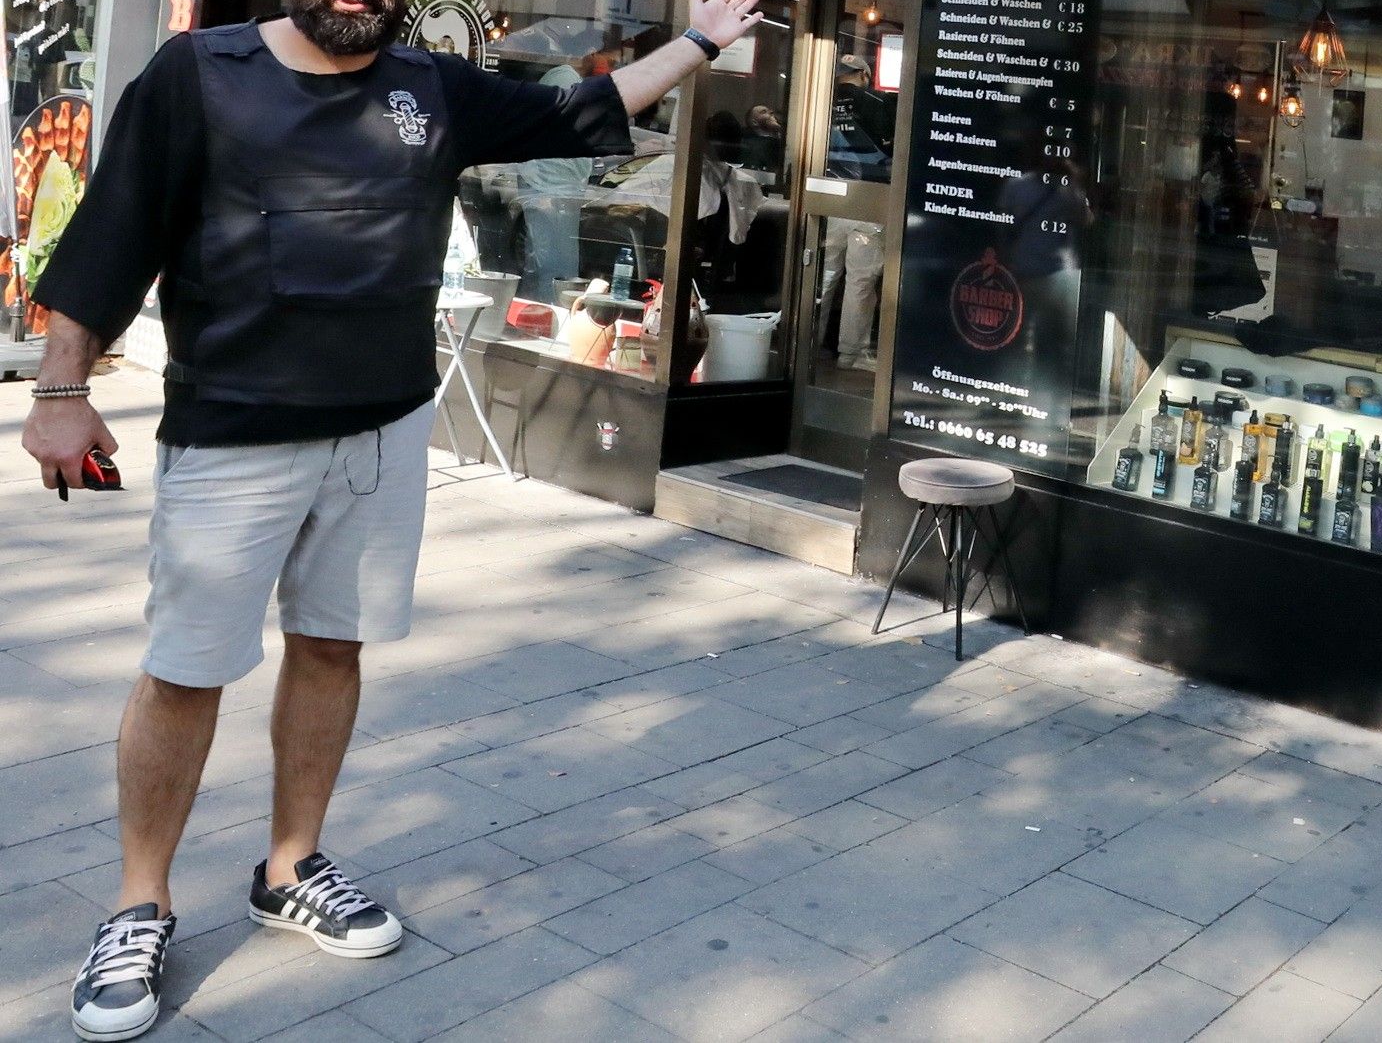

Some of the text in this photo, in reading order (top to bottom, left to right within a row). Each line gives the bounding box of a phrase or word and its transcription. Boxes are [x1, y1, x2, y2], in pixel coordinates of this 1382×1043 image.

[403, 0, 423, 26] THE
[1058, 2, 1067, 13] €
[1070, 2, 1085, 15] 18
[939, 12, 1083, 34] Schneiden & Waschen & € 25
[938, 30, 1025, 47] Rasieren & Föhnen
[936, 48, 1080, 72] Schneiden & Waschen & € 30
[935, 66, 1053, 89] Rasieren & Augenbrauenzupfen
[934, 85, 1076, 112] Waschen & Föhnen € 5
[932, 112, 1073, 139] Rasieren € 7
[930, 130, 1071, 158] Mode Rasieren € 10
[928, 157, 1069, 187] Augenbrauenzupfen € 6
[926, 183, 974, 200] KINDER
[924, 201, 1067, 234] Kinder Haarschnitt € 12
[912, 381, 933, 395] Mo.
[941, 387, 965, 402] Sa.:
[932, 365, 1030, 398] Öffnungszeiten:
[903, 410, 1048, 457] Tel.: 0660 65 48 525
